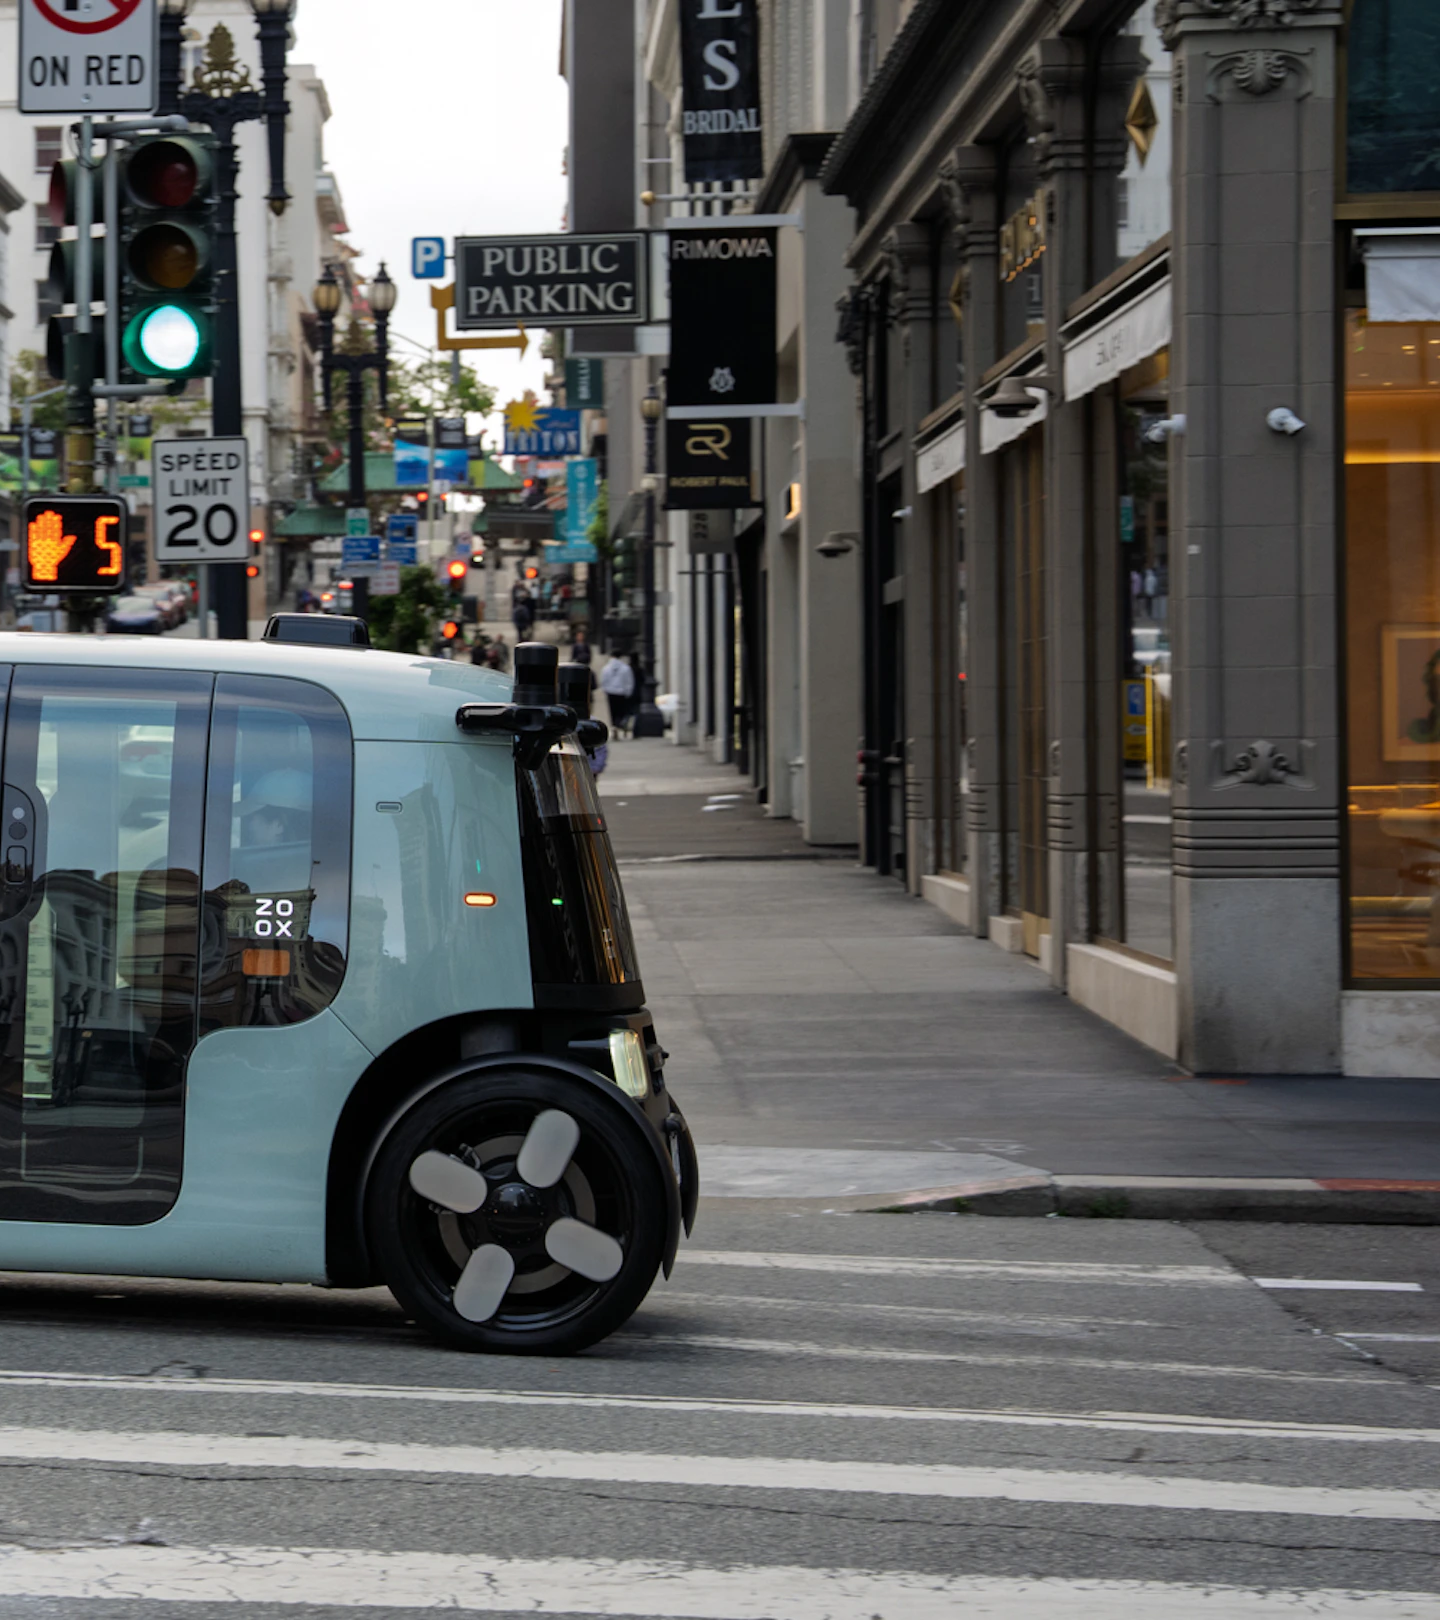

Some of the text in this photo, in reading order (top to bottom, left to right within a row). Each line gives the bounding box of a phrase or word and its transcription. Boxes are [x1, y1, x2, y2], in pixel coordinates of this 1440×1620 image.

[29, 54, 144, 86] ON RED
[683, 108, 762, 134] BRIDAL
[415, 240, 441, 274] P
[482, 244, 620, 277] PUBLIC
[672, 237, 773, 261] RIMOWA
[468, 281, 634, 316] PARKING
[161, 453, 241, 472] SPEED
[169, 478, 232, 497] LIMIT
[165, 503, 238, 547] 20
[95, 515, 122, 575] 5
